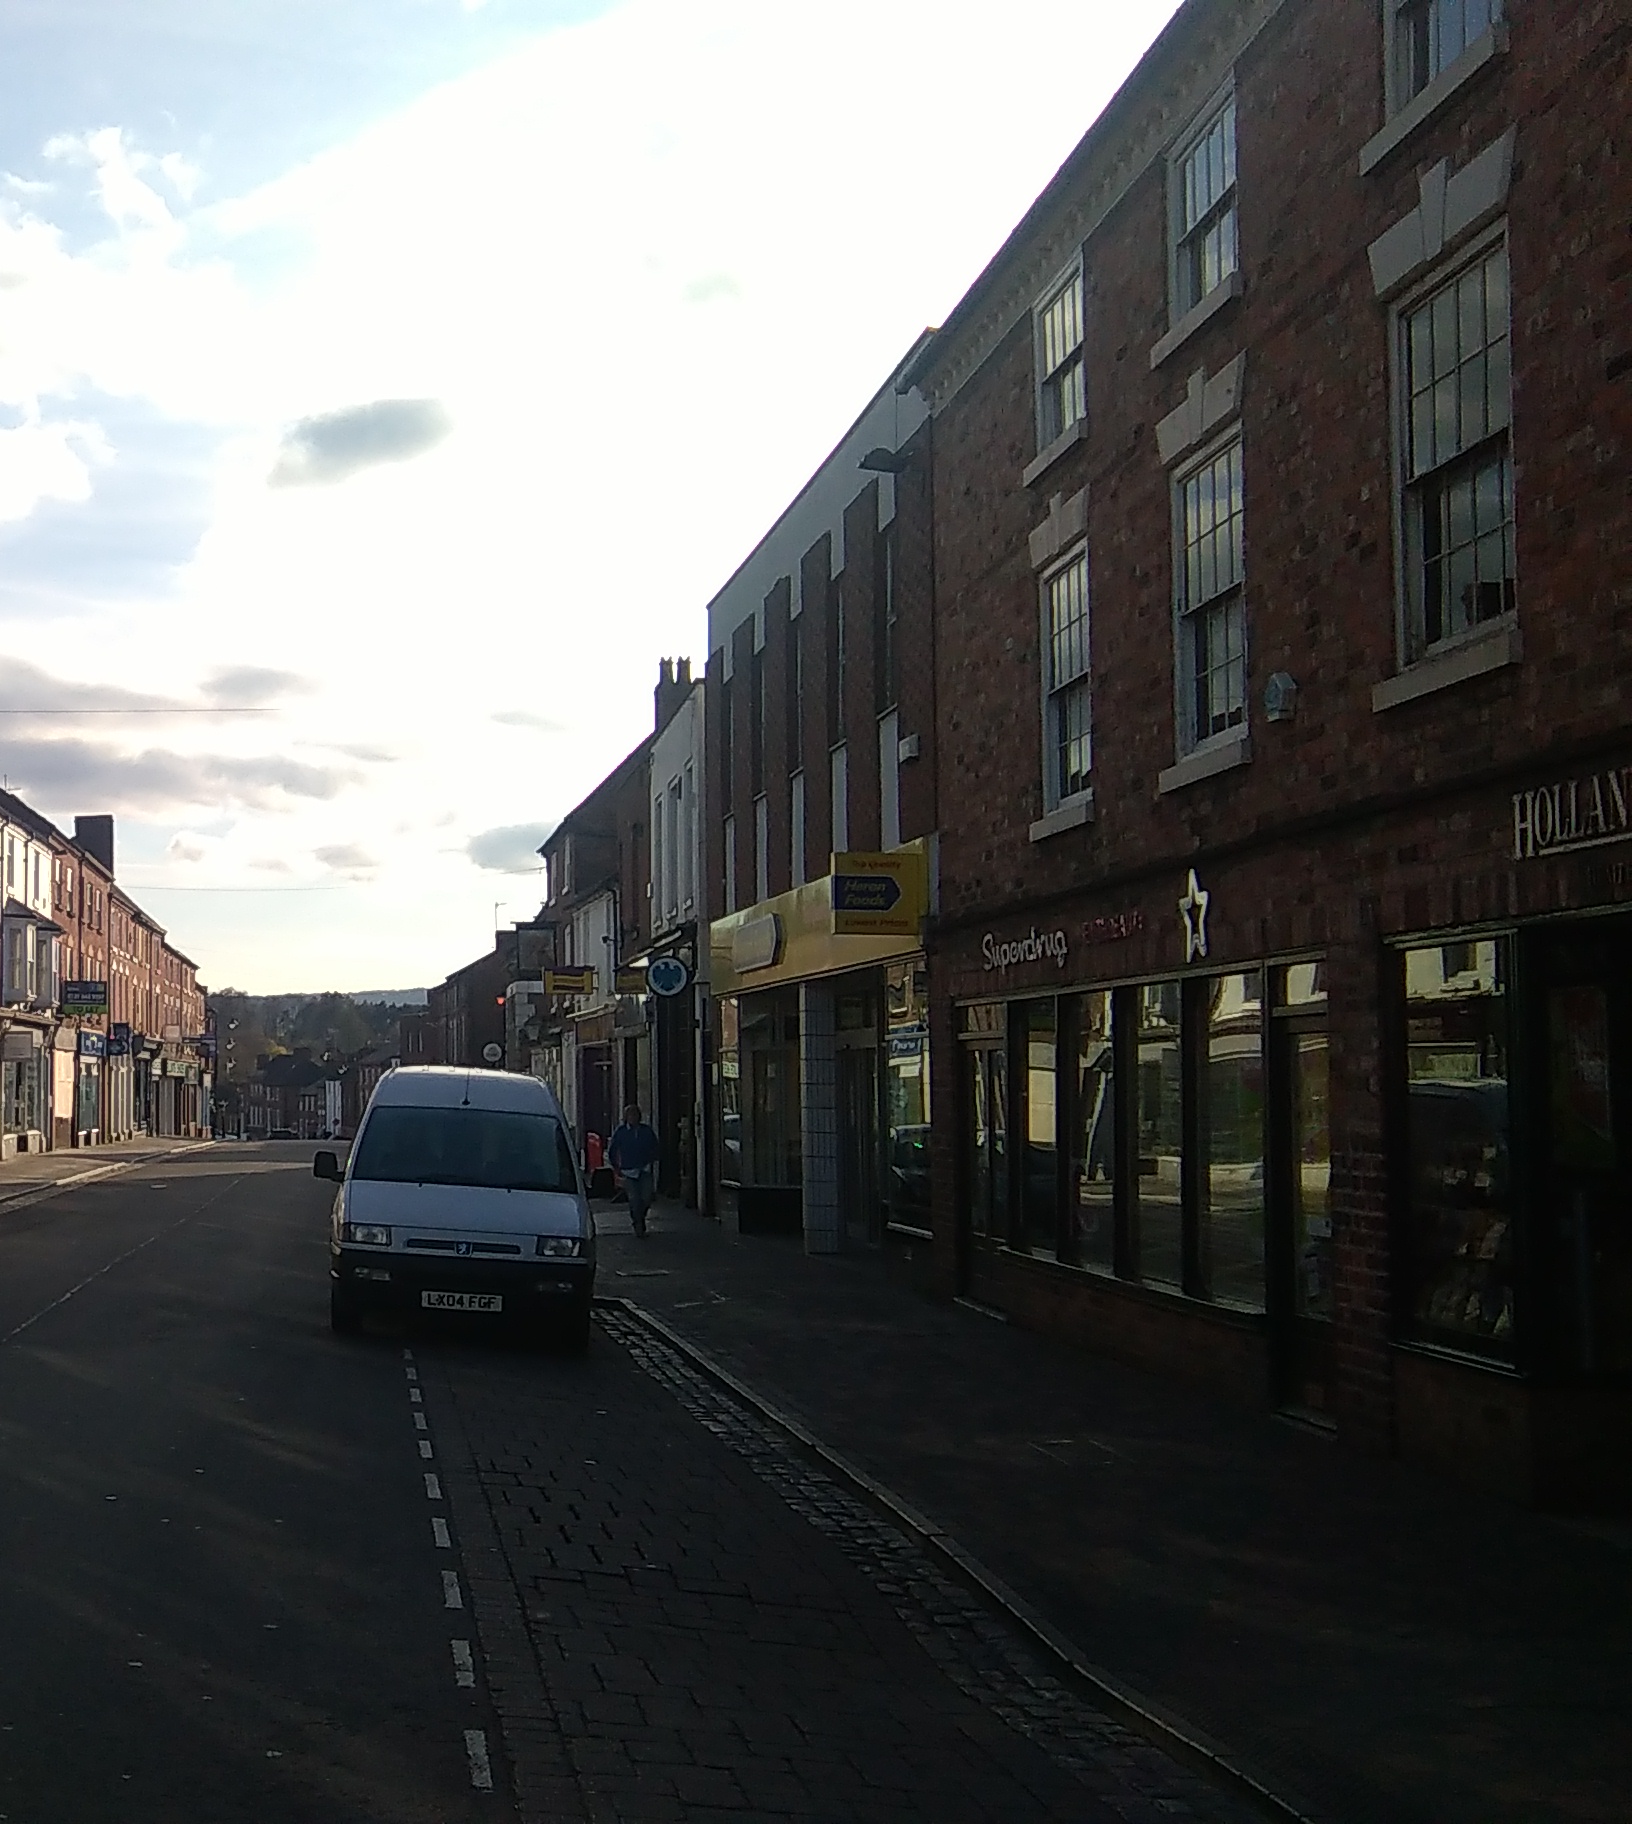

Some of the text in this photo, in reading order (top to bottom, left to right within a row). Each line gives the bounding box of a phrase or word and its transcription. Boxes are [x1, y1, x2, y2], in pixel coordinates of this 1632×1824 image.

[845, 880, 886, 892] Heron
[845, 894, 886, 906] Foods
[982, 926, 1069, 975] Superdrug
[427, 1293, 497, 1309] LX04 FGF
